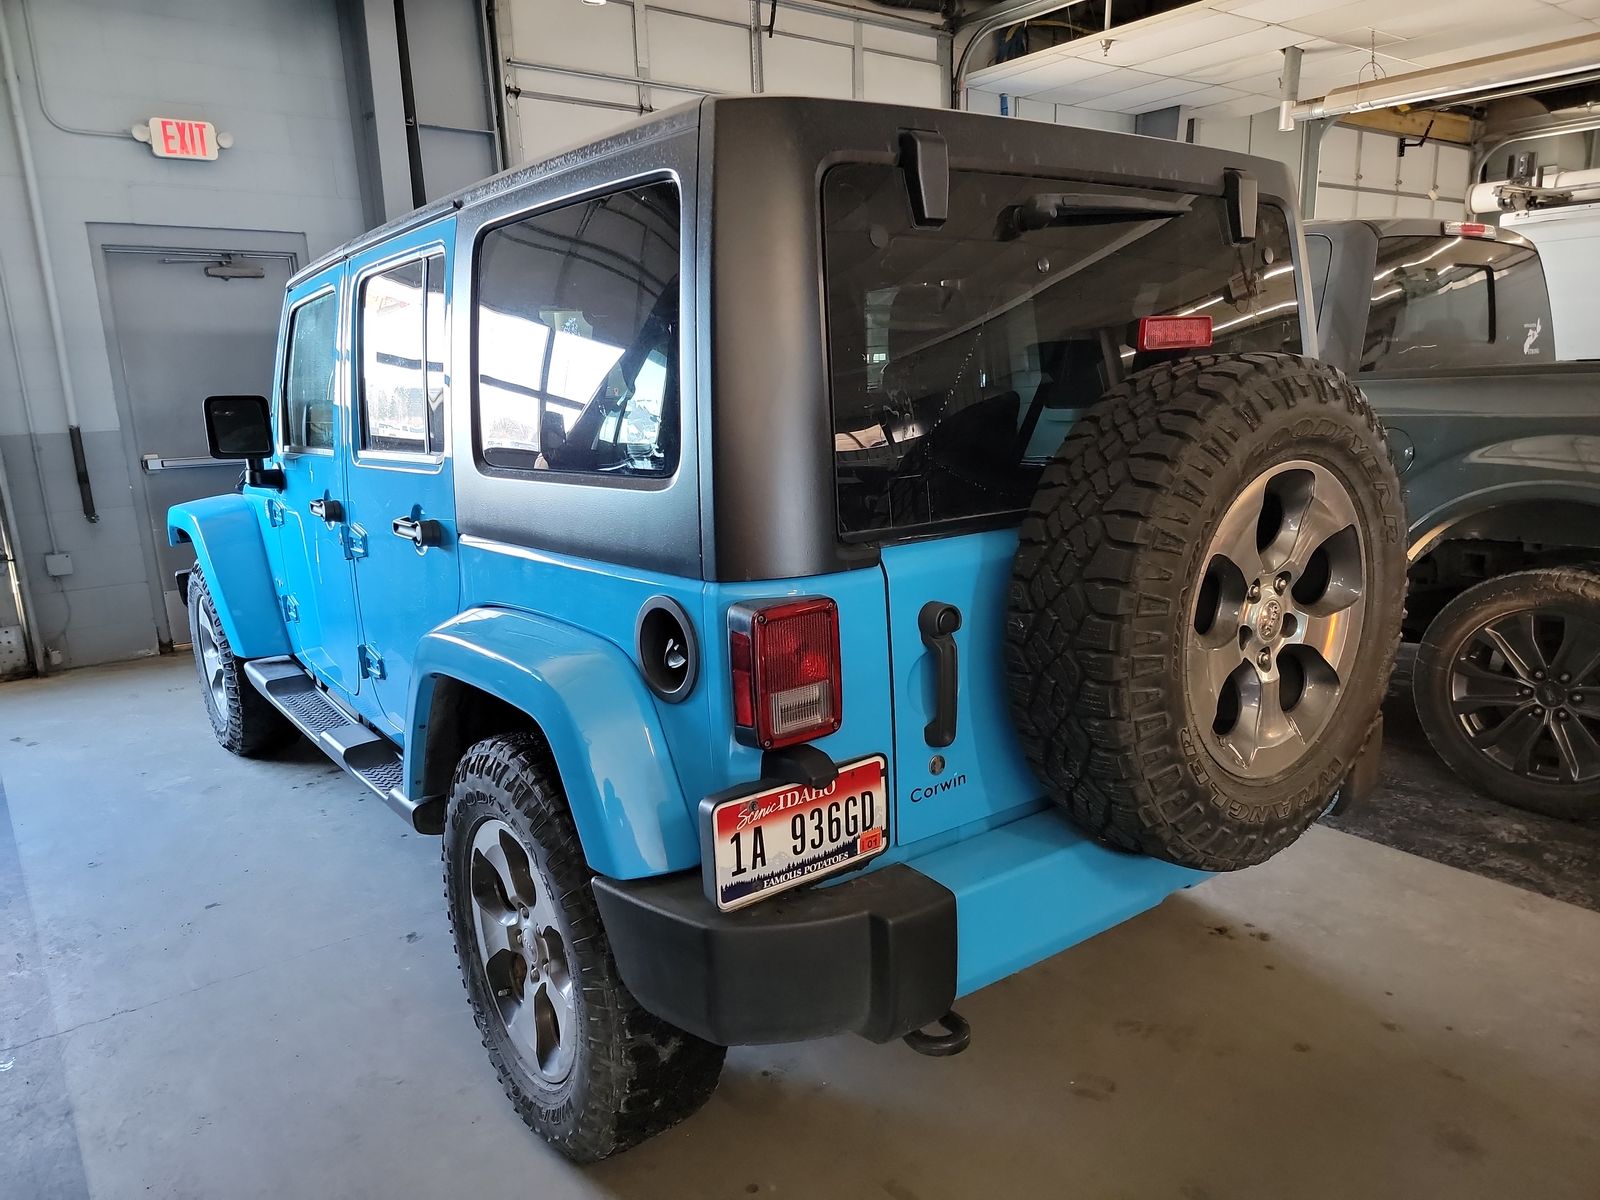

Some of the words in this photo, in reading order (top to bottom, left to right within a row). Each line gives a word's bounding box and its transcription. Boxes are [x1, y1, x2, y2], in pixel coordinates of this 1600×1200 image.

[160, 120, 207, 157] EXIT
[910, 771, 967, 803] Corwin
[1179, 726, 1343, 824] WRANGLER
[730, 825, 767, 877] 1A
[791, 790, 875, 856] 936GD
[736, 801, 780, 831] Scenic
[762, 867, 802, 889] FAMOUS
[803, 850, 849, 876] POTATOES
